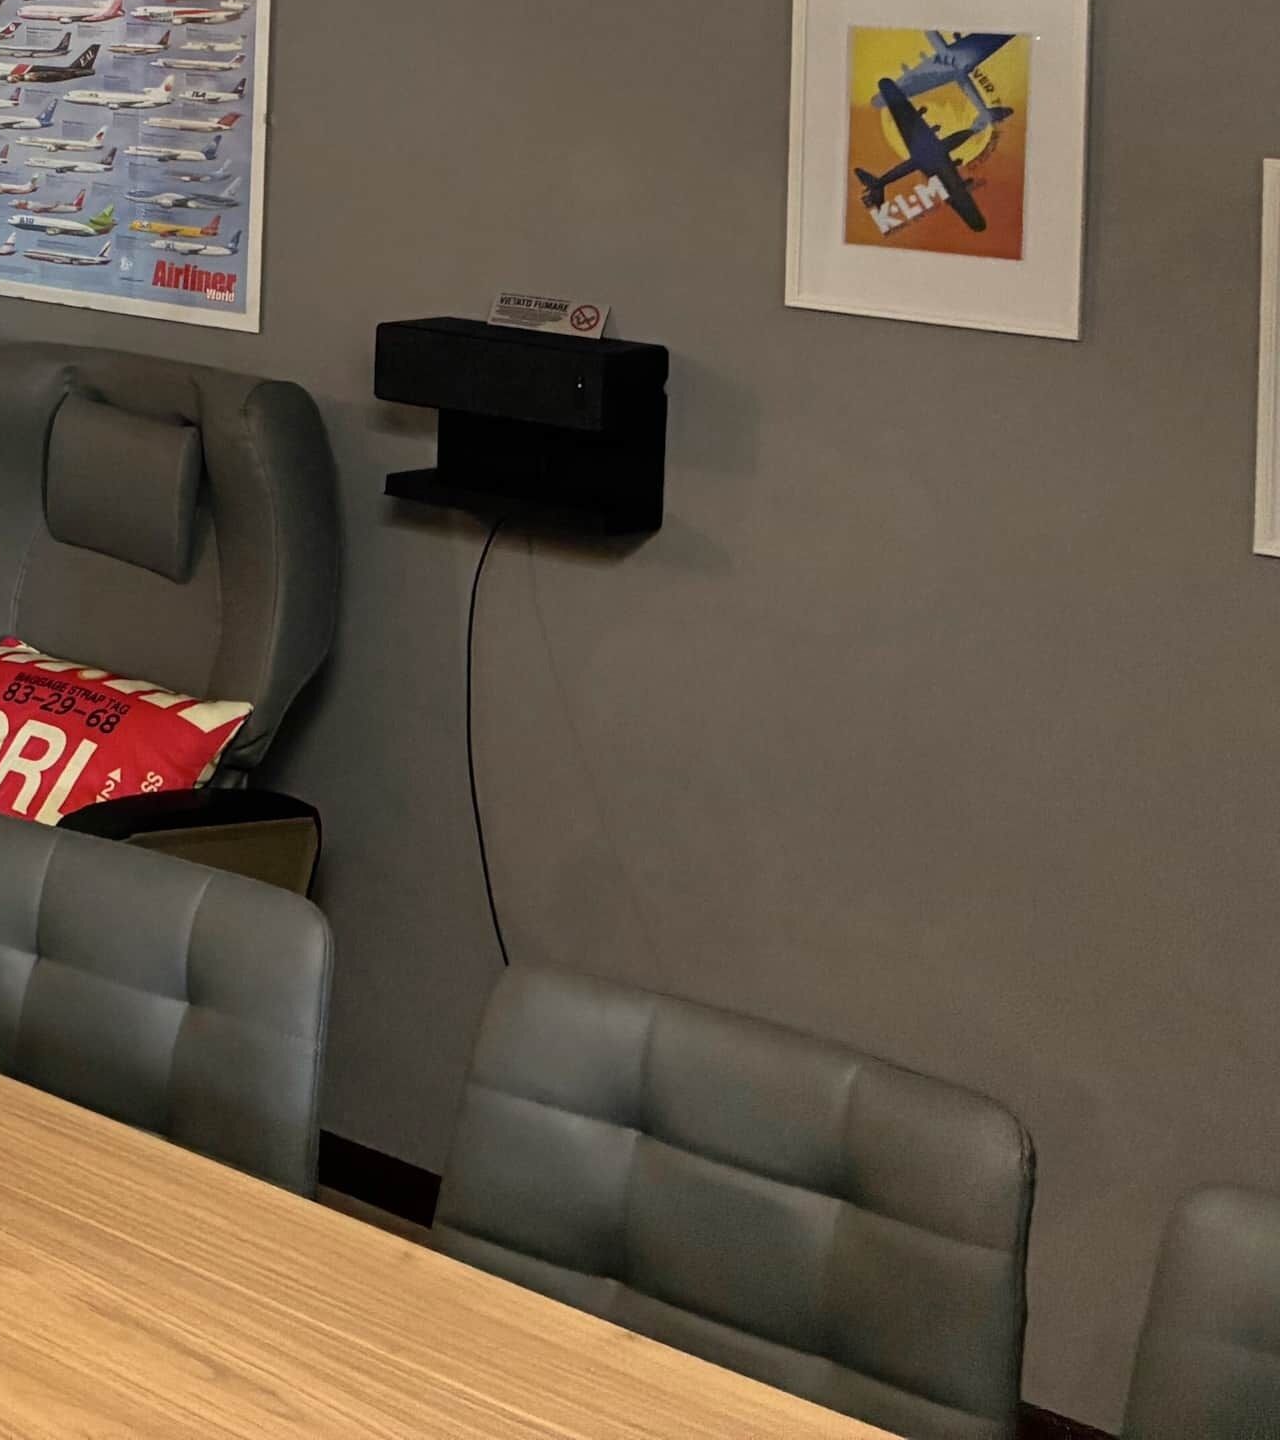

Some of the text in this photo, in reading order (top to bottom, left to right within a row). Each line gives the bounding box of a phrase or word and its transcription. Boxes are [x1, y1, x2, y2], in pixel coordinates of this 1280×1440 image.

[152, 259, 238, 294] Airliner
[206, 288, 235, 302] World
[2, 681, 122, 735] 83-29-68
[67, 682, 106, 707] STRAP
